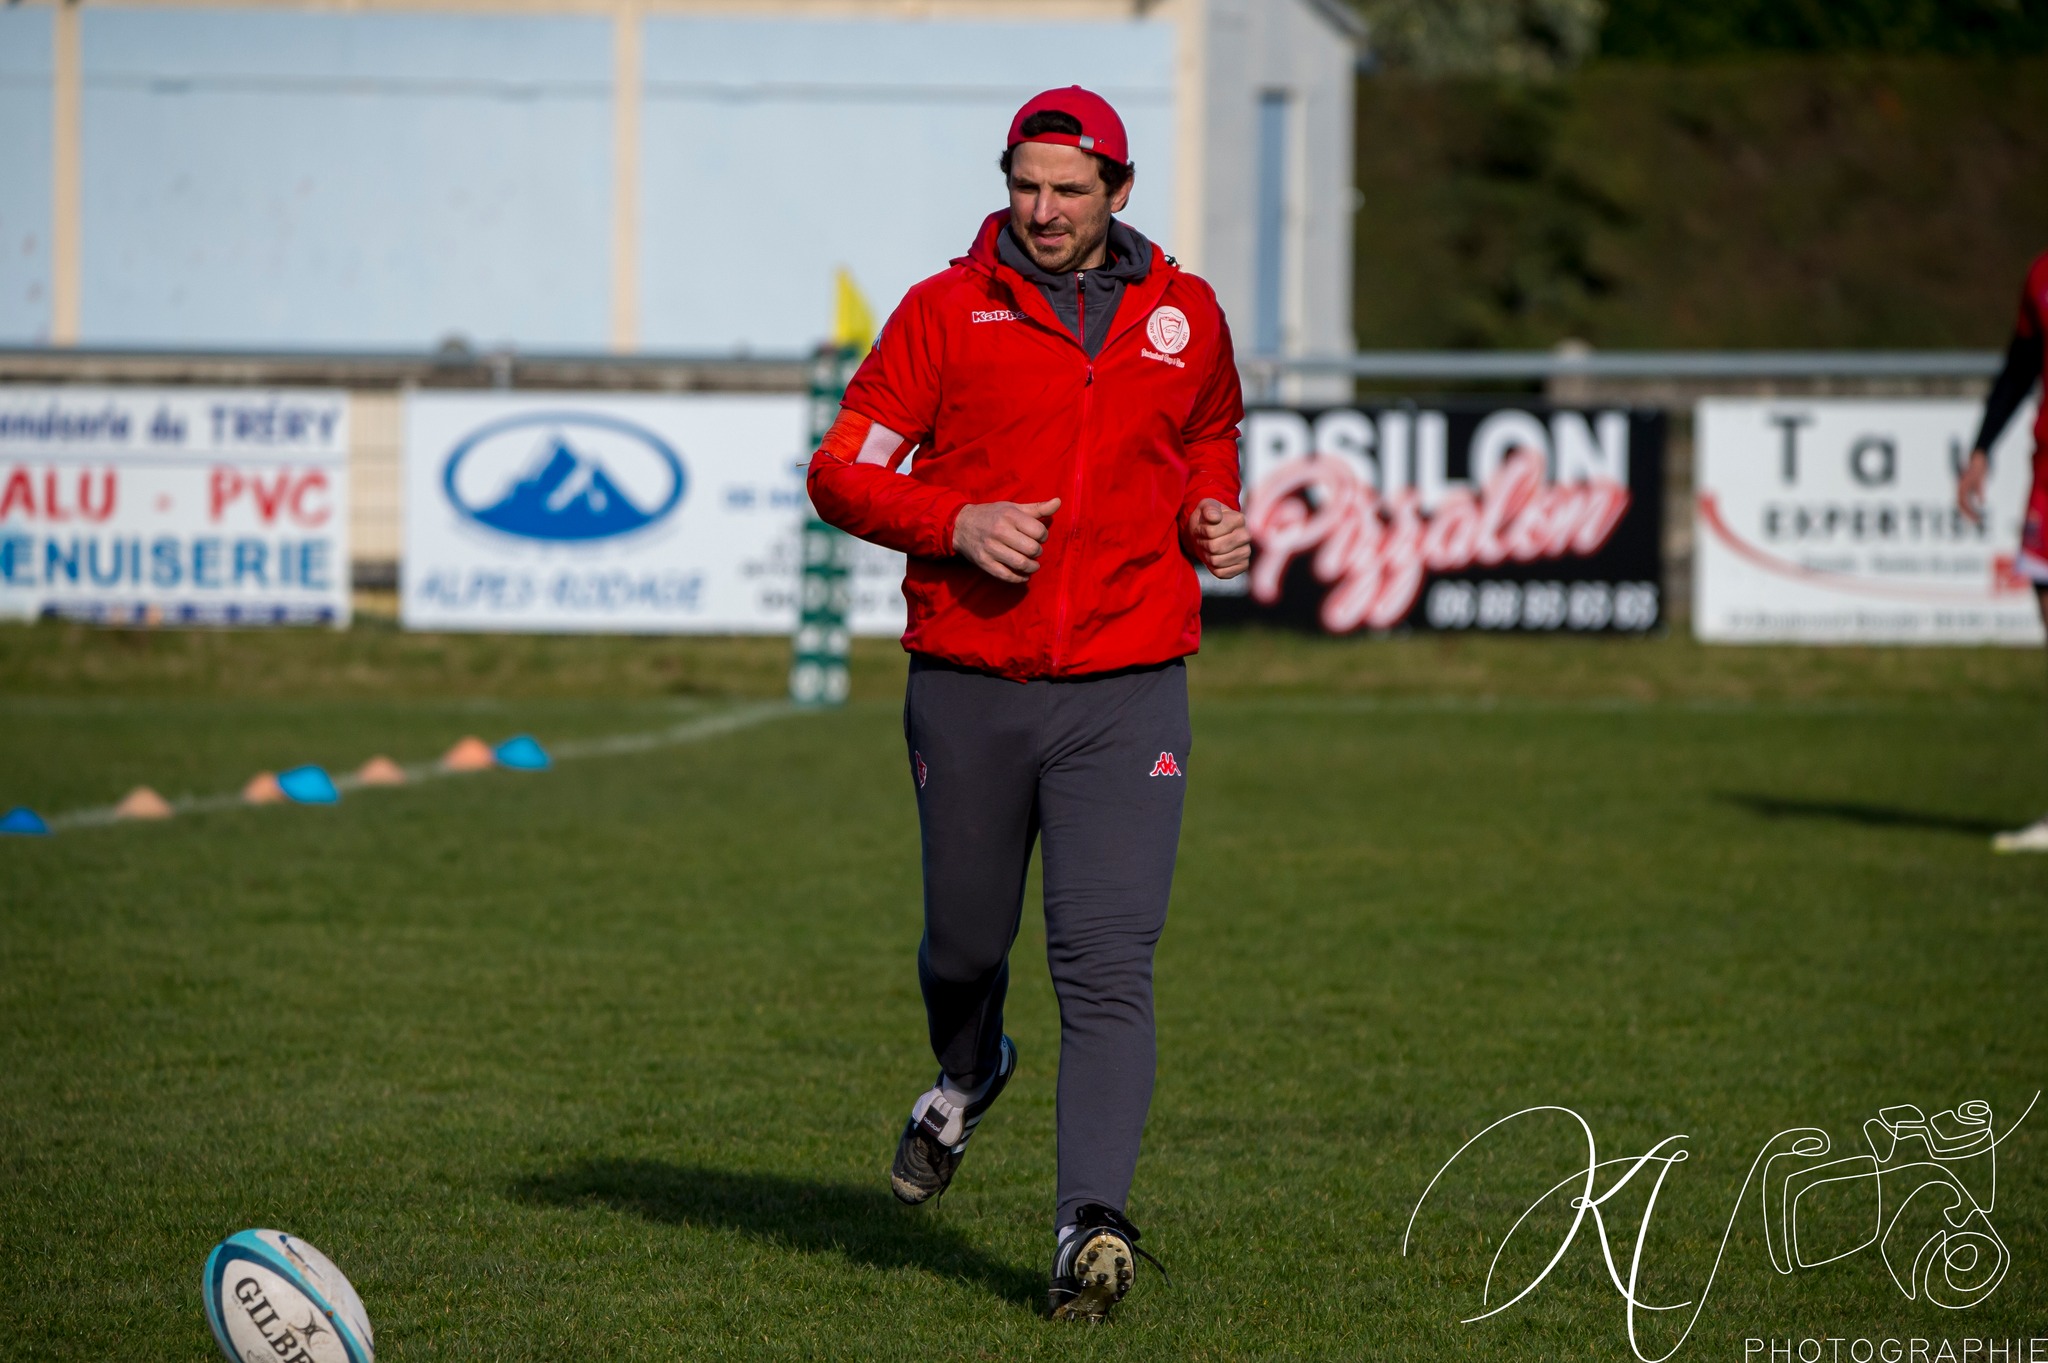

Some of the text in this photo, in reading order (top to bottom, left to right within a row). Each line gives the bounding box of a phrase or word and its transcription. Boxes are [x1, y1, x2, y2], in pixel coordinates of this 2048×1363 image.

[971, 309, 1028, 323] Kappa
[1240, 408, 1632, 500] PSILON
[0, 464, 116, 523] ALU
[209, 464, 332, 526] PVC
